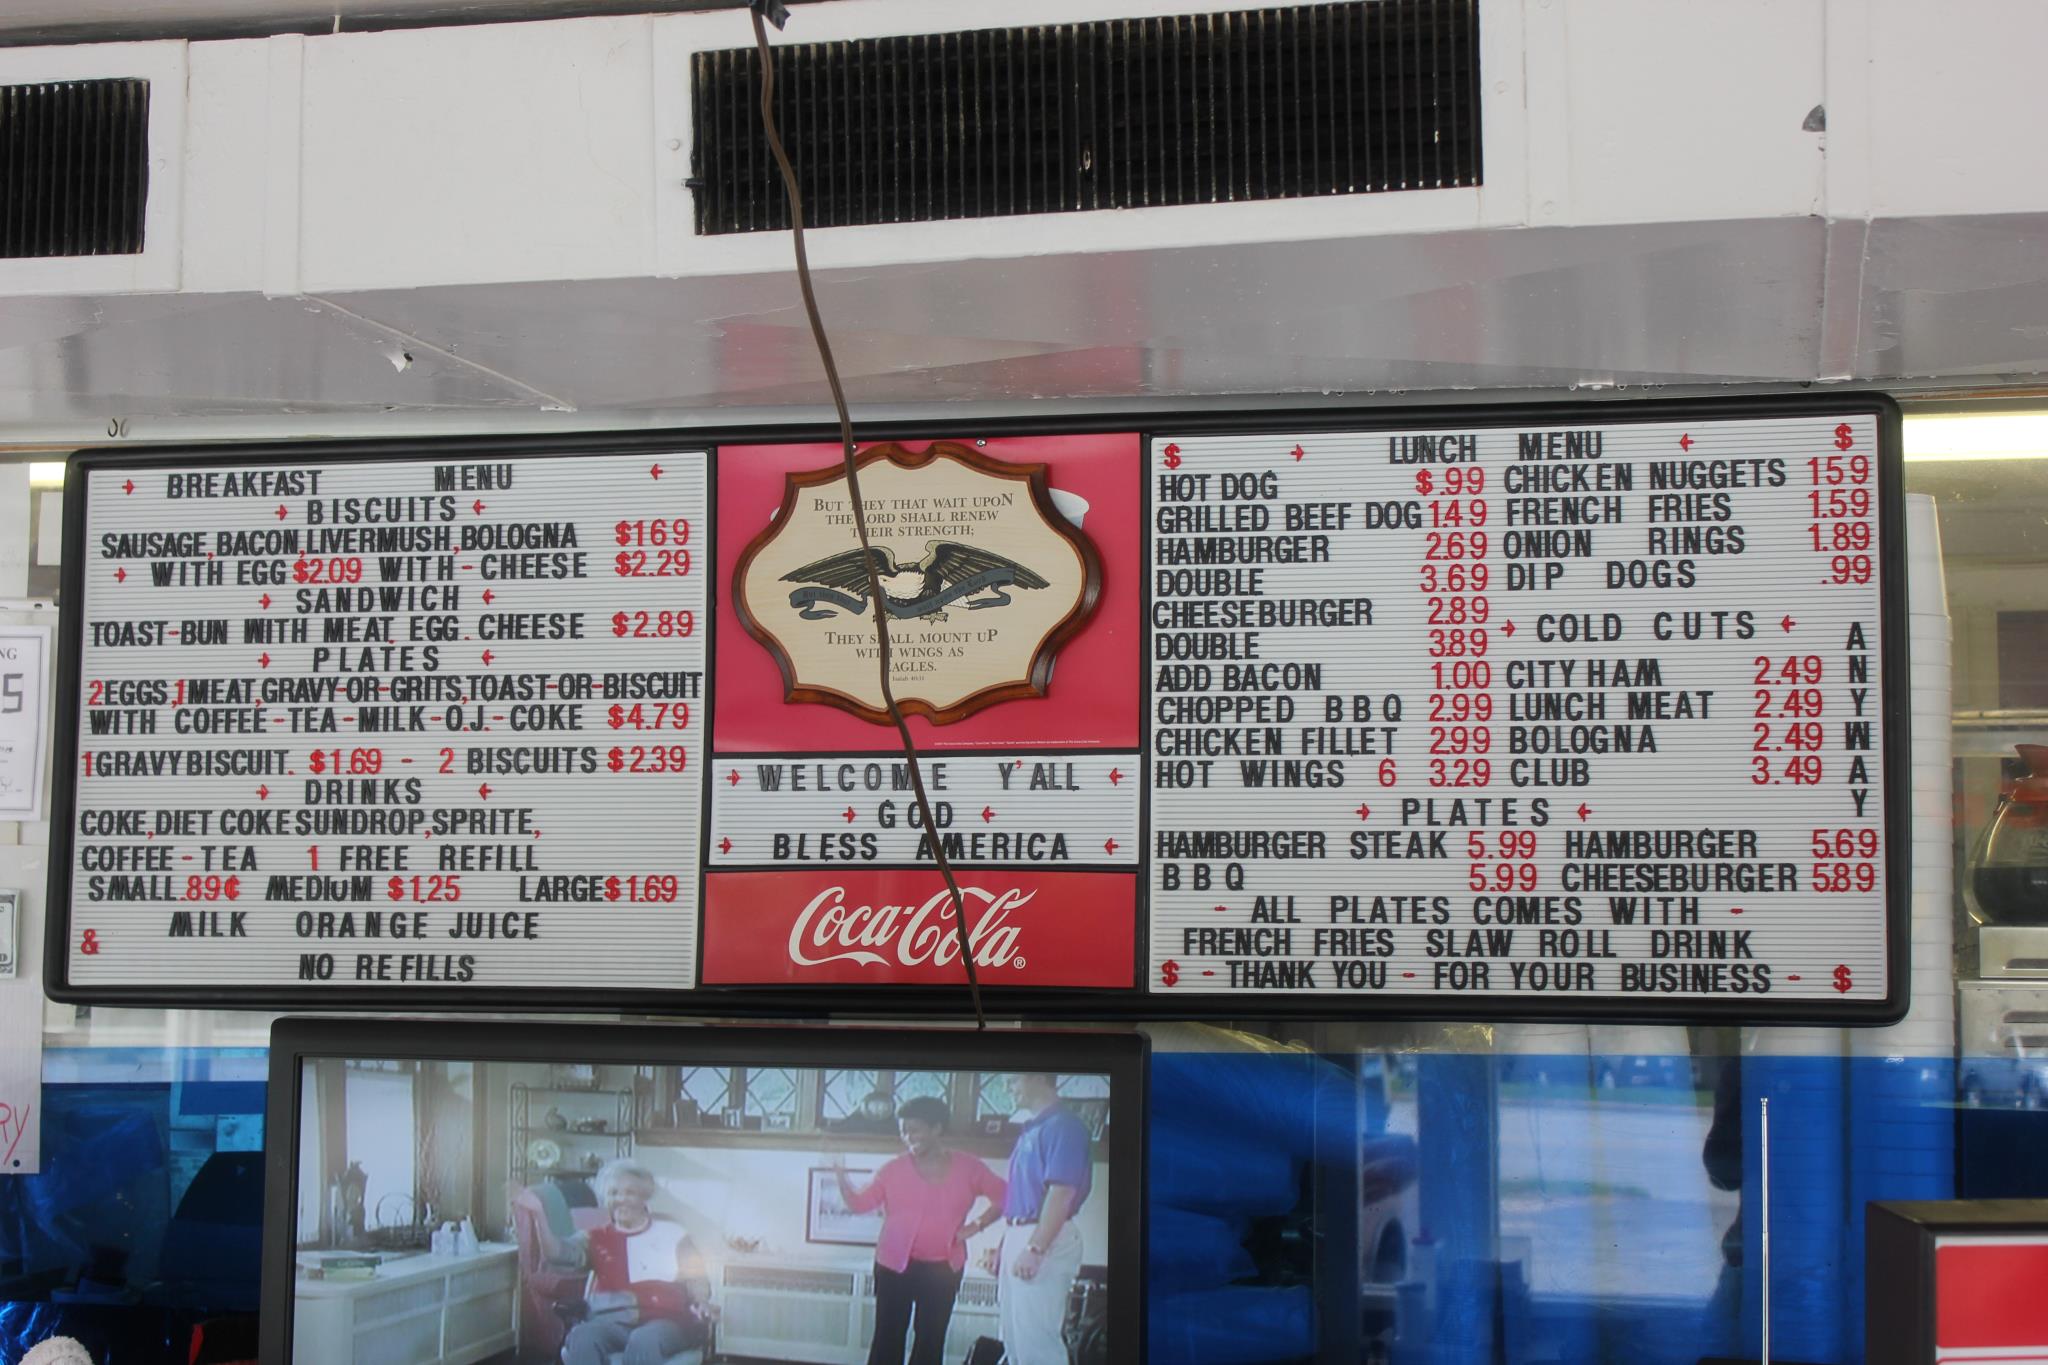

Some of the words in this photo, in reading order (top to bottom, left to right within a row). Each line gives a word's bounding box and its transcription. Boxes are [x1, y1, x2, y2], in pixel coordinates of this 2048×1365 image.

[1389, 434, 1477, 466] LUNCH
[1518, 430, 1603, 461] MENU
[167, 470, 322, 499] BREAKFAST
[434, 464, 512, 491] MENU
[1159, 473, 1212, 502] HOT
[1221, 469, 1279, 501] DOG
[1503, 462, 1633, 494] CHICKEN
[1649, 457, 1787, 490] NUGGETS
[307, 495, 456, 525] BISCUITS
[826, 513, 853, 525] THE
[900, 512, 944, 523] SHALL
[950, 510, 999, 522] RENEW
[891, 498, 928, 510] THAT
[933, 497, 968, 509] WAIT
[1157, 504, 1271, 534] GRILLED
[1285, 502, 1352, 532] BEEF
[1365, 499, 1423, 530] DOG
[1506, 496, 1622, 526] FRENCH
[1649, 492, 1732, 523] FRIES
[1807, 487, 1871, 519] 1.59
[898, 525, 975, 537] STRENGTH;
[1157, 534, 1331, 566] HAMBURGER
[1425, 530, 1489, 561] 2.69
[1502, 528, 1592, 560] ONION
[1648, 525, 1745, 556] RINGS
[1807, 521, 1872, 552] 1.89
[151, 559, 223, 587] WITH
[237, 558, 287, 586] EGG
[292, 556, 362, 584] $2.09
[379, 555, 454, 583] WITH
[480, 552, 587, 581] CHEESE
[614, 549, 691, 578] $2.29
[1157, 567, 1264, 598] DOUBLE
[1419, 562, 1490, 594] 3.69
[1506, 561, 1565, 591] DIP
[1606, 559, 1697, 590] DOGS
[1821, 554, 1873, 585] .99
[296, 584, 460, 614] SANDWICH
[244, 617, 307, 645] WITH
[478, 612, 585, 641] CHEESE
[611, 609, 695, 639] $2.89
[1152, 597, 1373, 629] CHEESEBURGER
[1427, 596, 1490, 626] 2.89
[1536, 613, 1623, 643] COLD
[1653, 610, 1756, 641] CUTS
[870, 634, 914, 645] SALL
[919, 633, 971, 644] MOUNT
[900, 647, 943, 658] WINGS
[948, 646, 964, 657] AS
[1155, 631, 1261, 661] DOUBLE
[313, 645, 438, 673] PLATES
[1155, 664, 1213, 693] ADD
[1222, 662, 1322, 693] BACON
[1430, 660, 1493, 690] 1.00
[1753, 655, 1823, 686] 2.49
[90, 706, 155, 735] WITH
[608, 701, 690, 731] $4.79
[1157, 695, 1295, 726] CHOPPED
[1428, 693, 1493, 722] 2.99
[1509, 691, 1606, 722] LUNCH
[1628, 690, 1714, 720] MEAT
[1753, 688, 1824, 719] 2.49
[1155, 727, 1283, 756] CHICKEN
[1301, 726, 1398, 757] FILLET
[1509, 724, 1658, 754] BOLOGNA
[1752, 721, 1824, 752] 2.49
[309, 746, 383, 776] $1.69
[438, 746, 455, 774] 2
[467, 746, 598, 776] BISCUITS
[607, 744, 688, 774] $2.39
[757, 762, 947, 793] WELCOME
[998, 758, 1080, 793] Y'ALL
[1155, 760, 1214, 789] HOT
[1240, 758, 1346, 789] WINGS
[1377, 756, 1397, 788] 6
[1428, 757, 1492, 788] 3.29
[1509, 757, 1591, 788] CLUB
[1750, 754, 1823, 786] 3.49
[304, 777, 422, 806] DRINKS
[155, 809, 213, 837] DIET
[878, 798, 954, 829] GOD
[1401, 797, 1550, 828] PLATES
[81, 845, 174, 873] COFFEE
[200, 845, 258, 872] TEA
[307, 844, 318, 872] 1
[340, 844, 408, 872] FREE
[439, 843, 539, 872] REFILL
[773, 832, 878, 863] BLESS
[915, 831, 1069, 862] AMERICA
[1156, 830, 1327, 861] HAMBURGER
[1349, 829, 1449, 861] STEAK
[1467, 829, 1538, 861] 5.99
[1565, 827, 1757, 859] HAMBURGER
[519, 875, 603, 902] LARGE
[604, 874, 678, 903] $1.69
[1468, 861, 1539, 893] 5.99
[1561, 861, 1798, 893] CHEESEBURGER
[168, 911, 248, 938] MILK
[296, 911, 428, 939] ORANGE
[449, 911, 539, 940] JUICE
[1250, 895, 1303, 925] ALL
[1329, 895, 1451, 926] PLATES
[1473, 895, 1584, 926] COMES
[1608, 896, 1700, 926] WITH
[80, 928, 100, 955] &
[1183, 927, 1292, 957] FRENCH
[1313, 927, 1396, 957] FRIES
[1425, 928, 1513, 958] SLAW
[1538, 928, 1618, 959] ROLL
[1650, 929, 1753, 960] DRINK
[298, 953, 334, 981] NO
[1225, 959, 1316, 989] THANK
[1331, 960, 1388, 990] YOU
[1433, 960, 1490, 991] FOR
[1510, 961, 1595, 992] YOUR
[1620, 962, 1772, 994] BUSINESS
